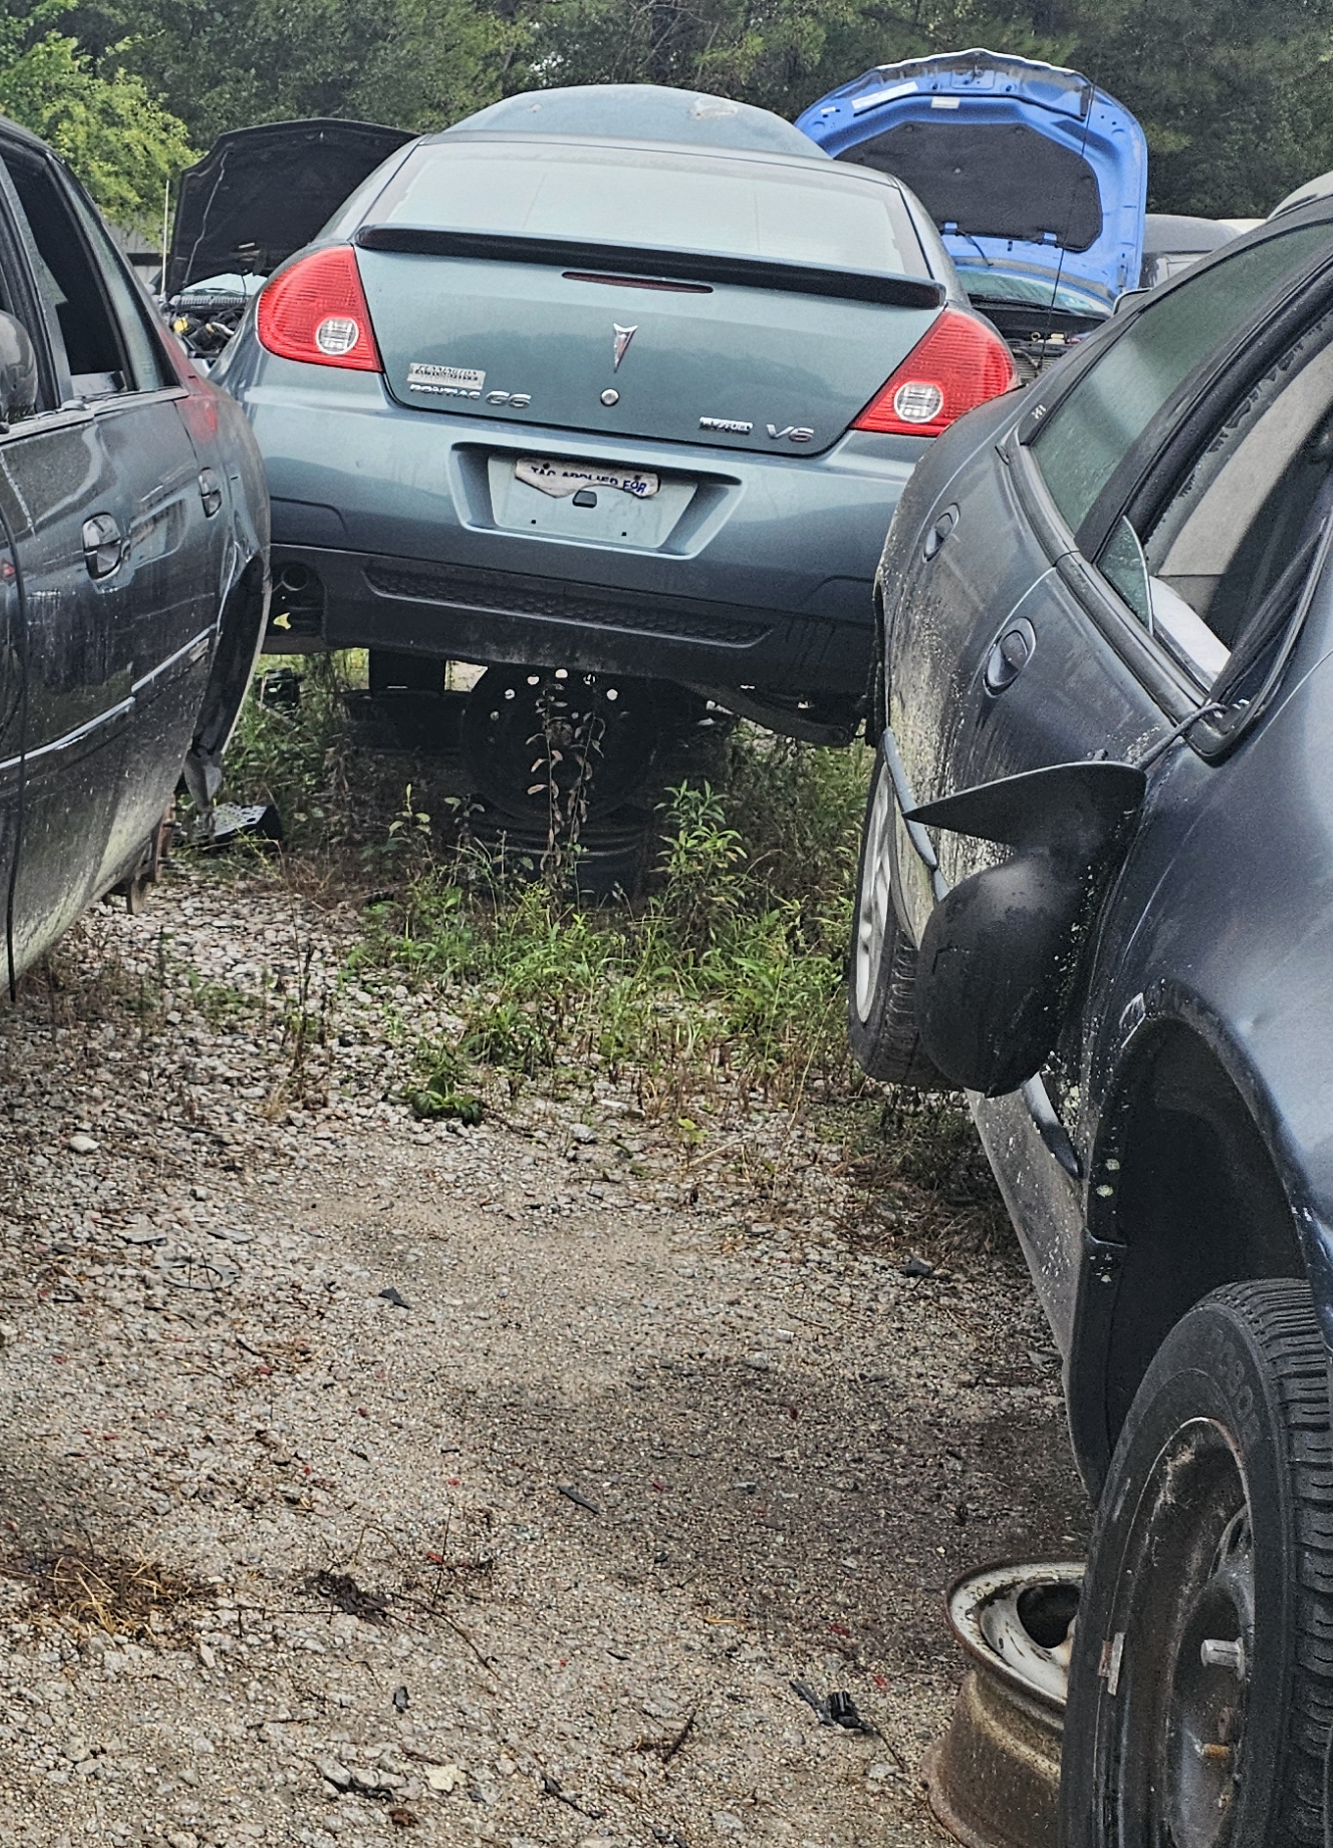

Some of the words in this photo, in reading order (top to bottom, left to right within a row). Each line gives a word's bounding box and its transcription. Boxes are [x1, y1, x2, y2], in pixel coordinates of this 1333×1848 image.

[409, 383, 481, 400] PONTIAC
[485, 389, 532, 409] G6
[766, 423, 815, 443] V6
